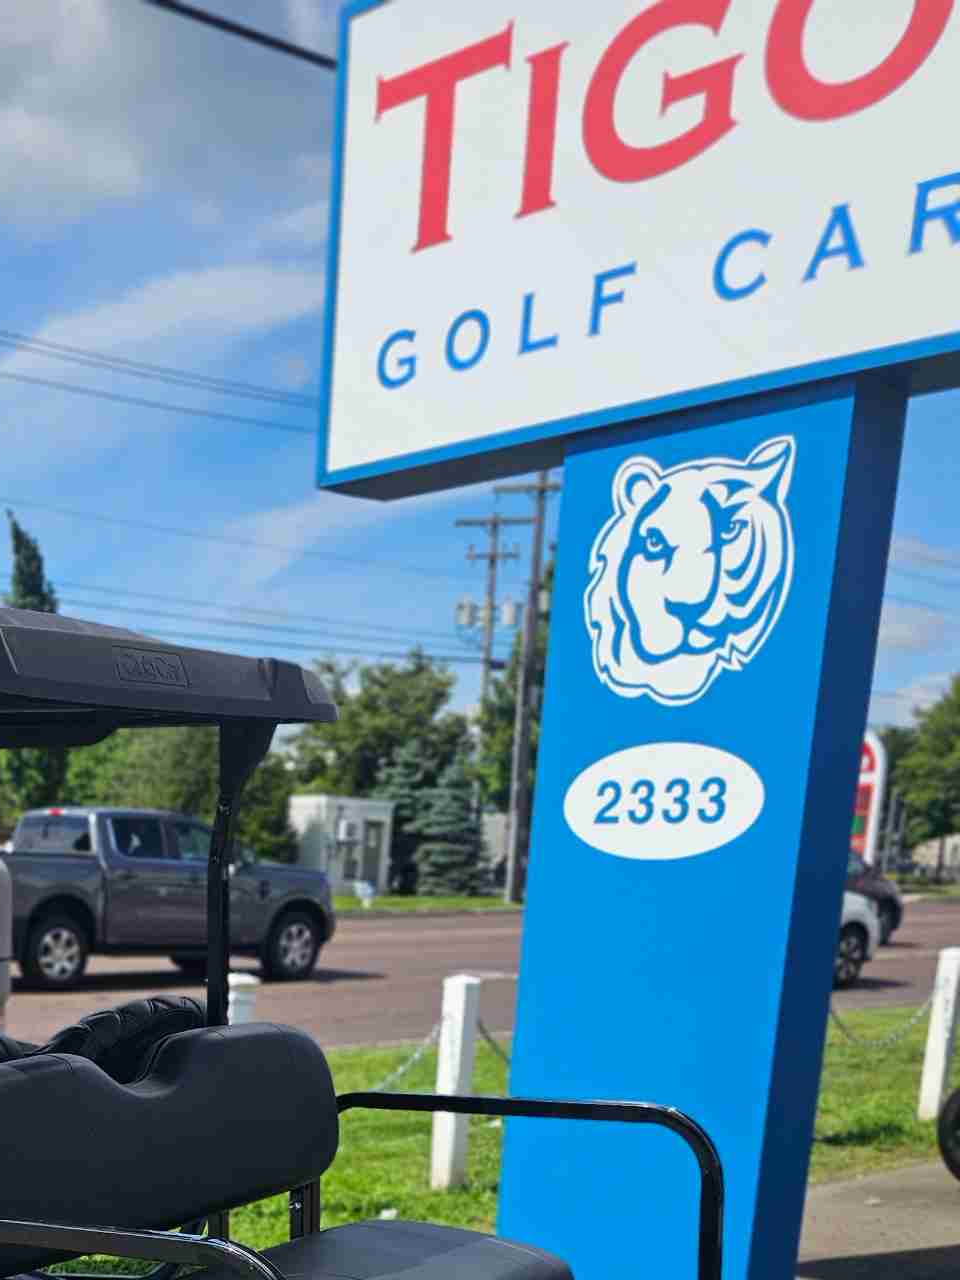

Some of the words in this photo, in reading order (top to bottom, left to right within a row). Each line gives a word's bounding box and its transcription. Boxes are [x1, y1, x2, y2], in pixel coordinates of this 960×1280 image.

[375, 0, 956, 252] TIGO
[376, 262, 638, 389] GOLF
[712, 171, 960, 301] CAR
[593, 776, 728, 825] 2333
